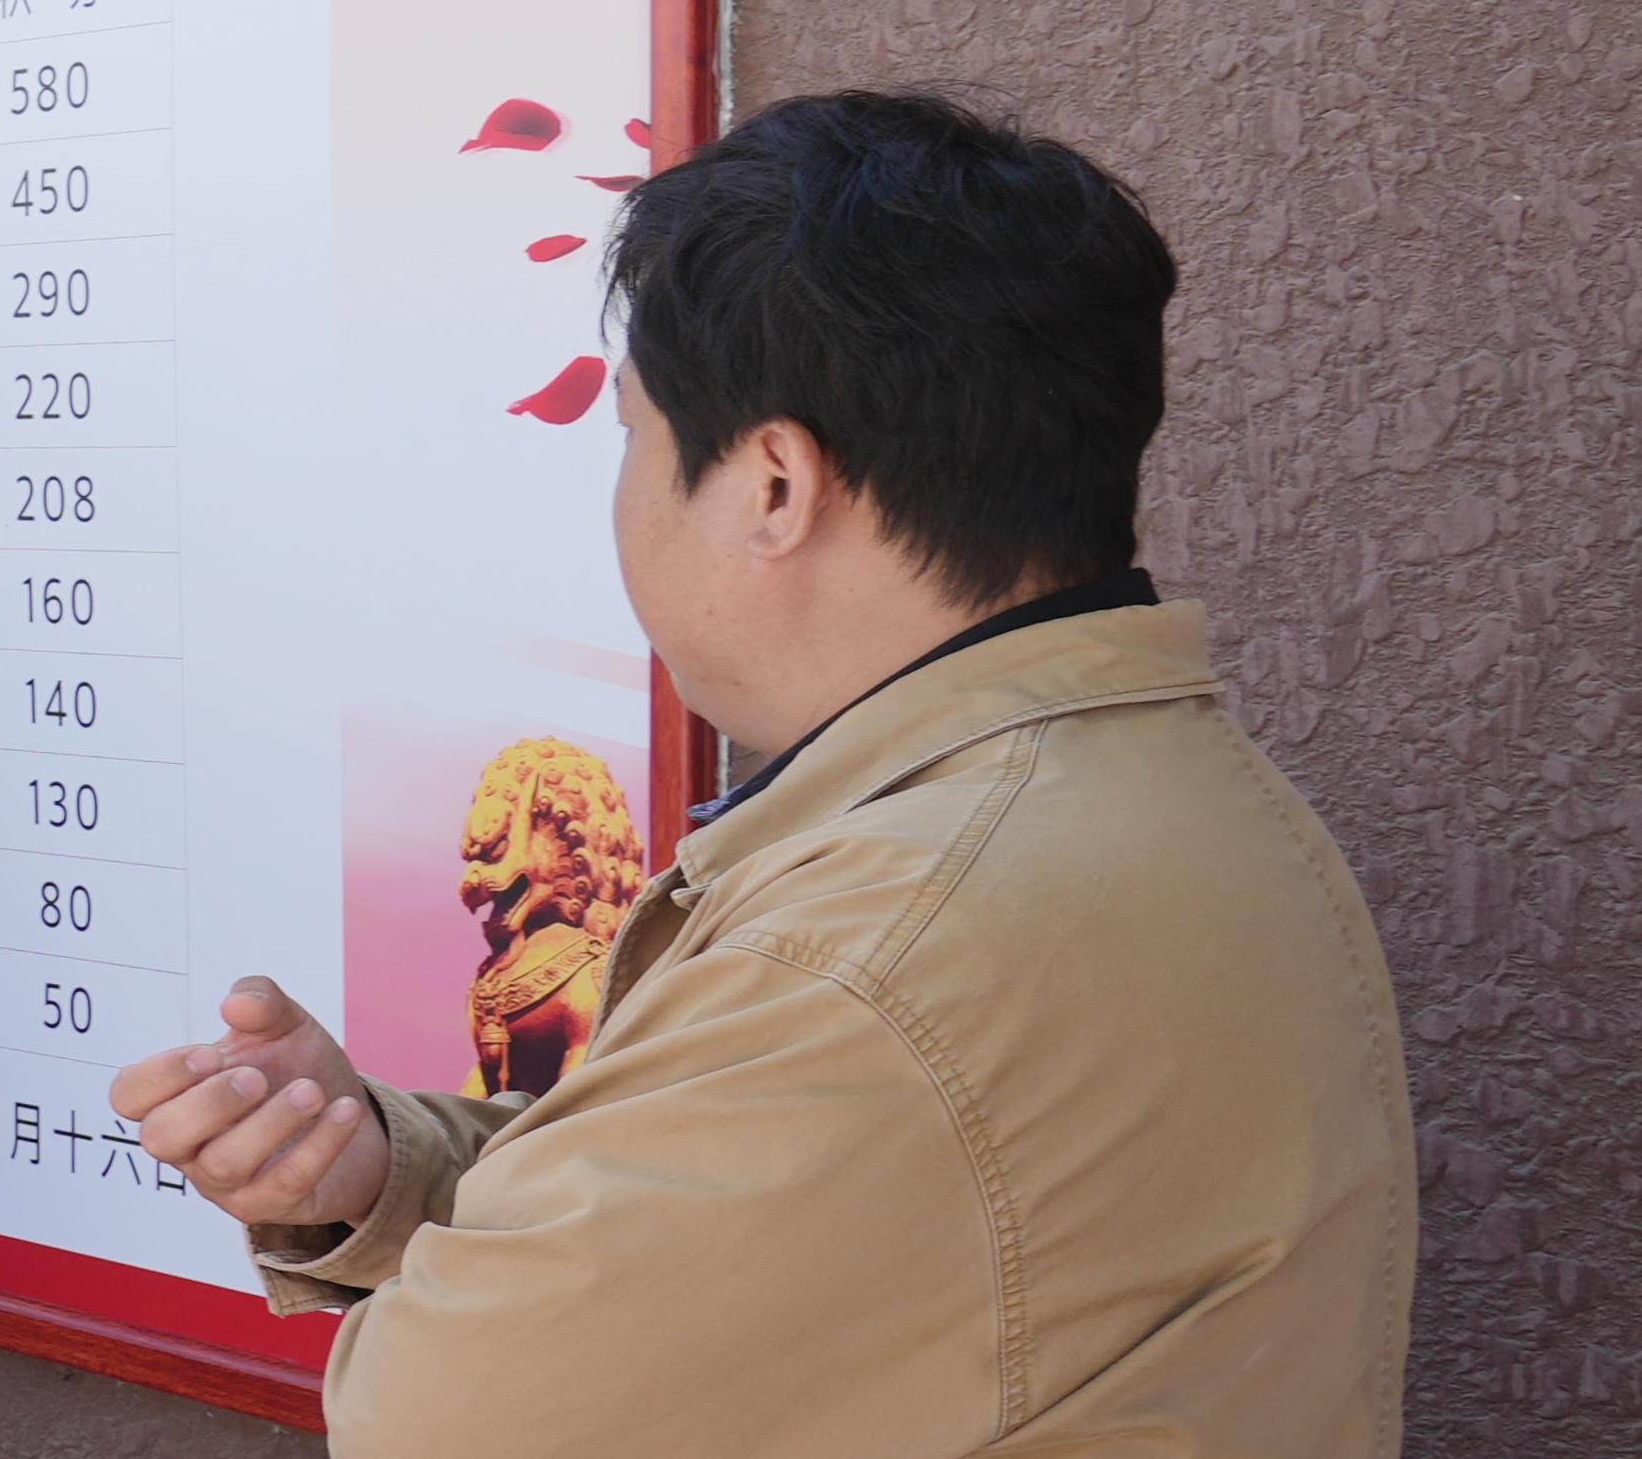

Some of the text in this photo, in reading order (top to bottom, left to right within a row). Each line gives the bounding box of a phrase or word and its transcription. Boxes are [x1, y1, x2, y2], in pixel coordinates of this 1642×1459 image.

[9, 60, 90, 116] 580
[10, 164, 90, 217] 450
[11, 268, 91, 319] 290
[14, 371, 92, 421] 220
[15, 474, 96, 524] 208
[21, 576, 95, 627] 160
[24, 677, 98, 730] 140
[27, 778, 100, 832] 130
[39, 880, 93, 933] 80
[42, 981, 93, 1035] 50
